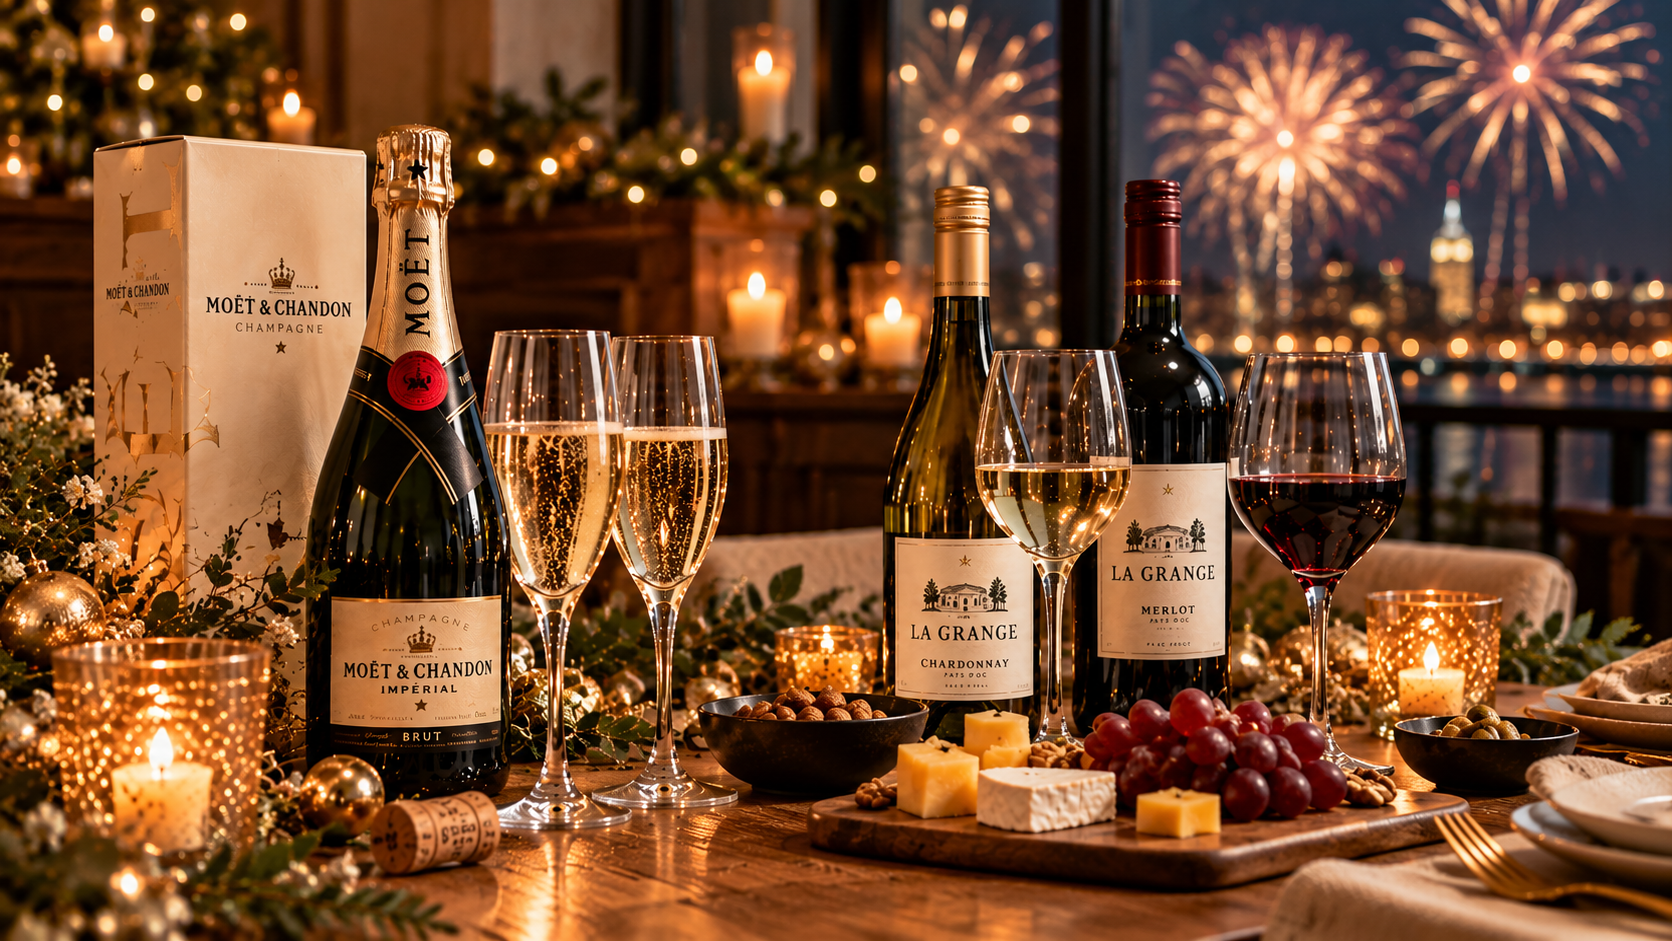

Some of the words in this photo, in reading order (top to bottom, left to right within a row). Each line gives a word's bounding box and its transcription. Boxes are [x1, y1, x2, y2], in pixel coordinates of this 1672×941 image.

[127, 287, 133, 298] &
[134, 283, 169, 298] CHANDON
[399, 229, 430, 338] MOËT
[206, 295, 255, 314] MOËT
[260, 300, 271, 315] &
[275, 300, 351, 317] CHANDON
[235, 322, 323, 334] CHAMPAGNE
[1112, 565, 1134, 581] LA
[1141, 565, 1215, 581] GRANGE
[1141, 605, 1195, 615] MERLOT
[371, 614, 470, 632] CHAMPAGNE
[911, 624, 931, 641] LA
[938, 624, 1018, 641] GRANGE
[343, 661, 392, 679] MOËT
[396, 664, 409, 680] &
[413, 660, 493, 679] CHANDON
[920, 658, 1009, 669] CHARDONNAY
[381, 683, 458, 695] IMPÉRIAL
[402, 731, 442, 742] BRUT
